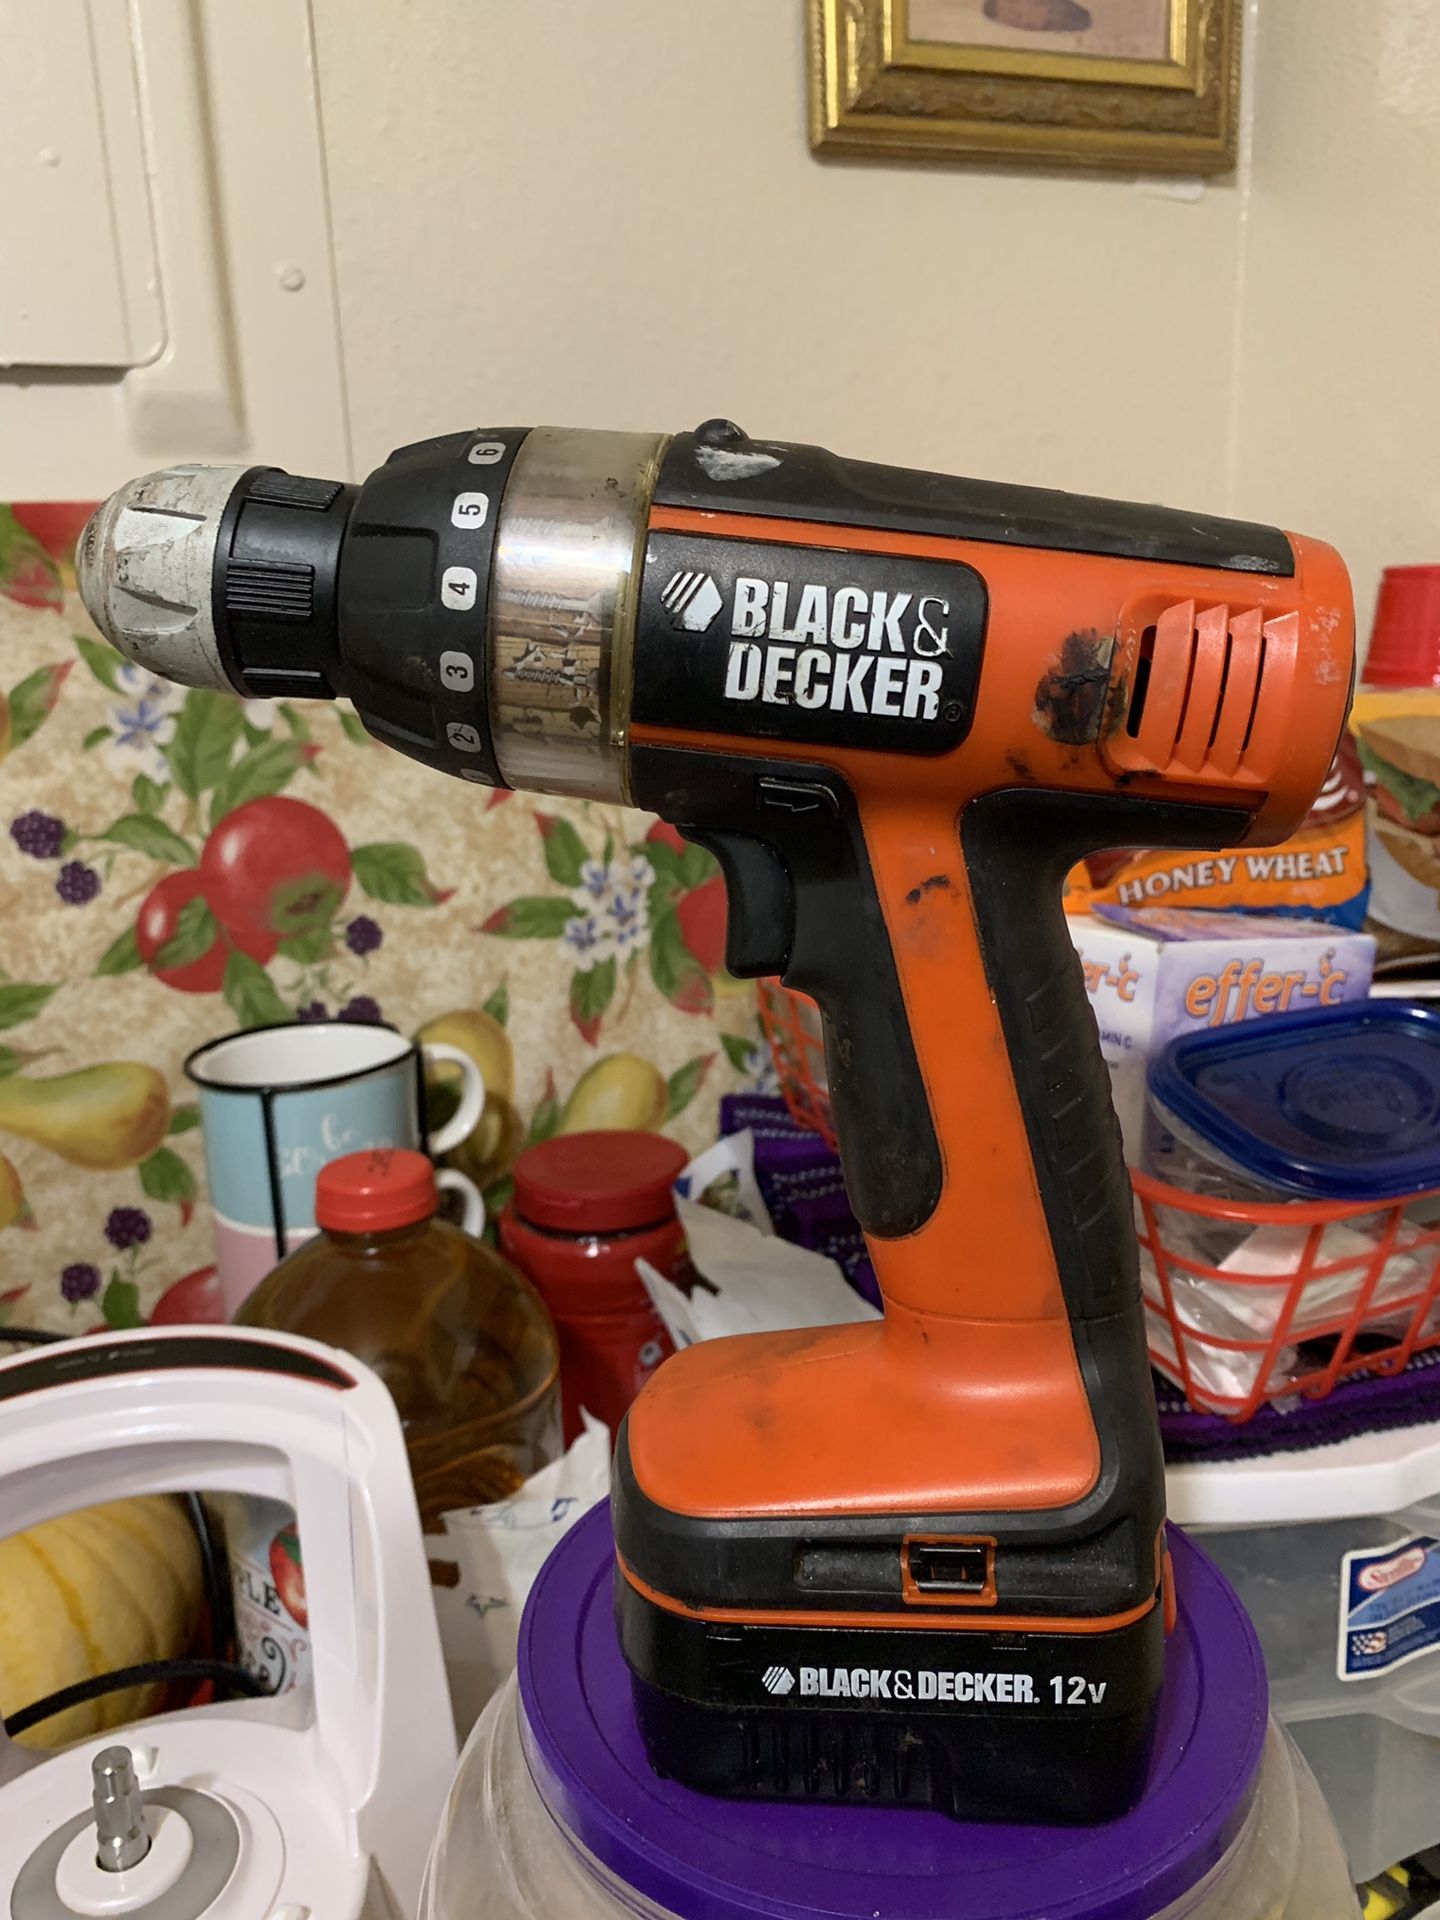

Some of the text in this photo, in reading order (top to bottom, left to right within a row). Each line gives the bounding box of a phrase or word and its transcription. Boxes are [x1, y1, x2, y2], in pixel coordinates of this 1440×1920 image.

[724, 640, 944, 721] DECKER
[1118, 848, 1349, 904] HONEY WHEAT
